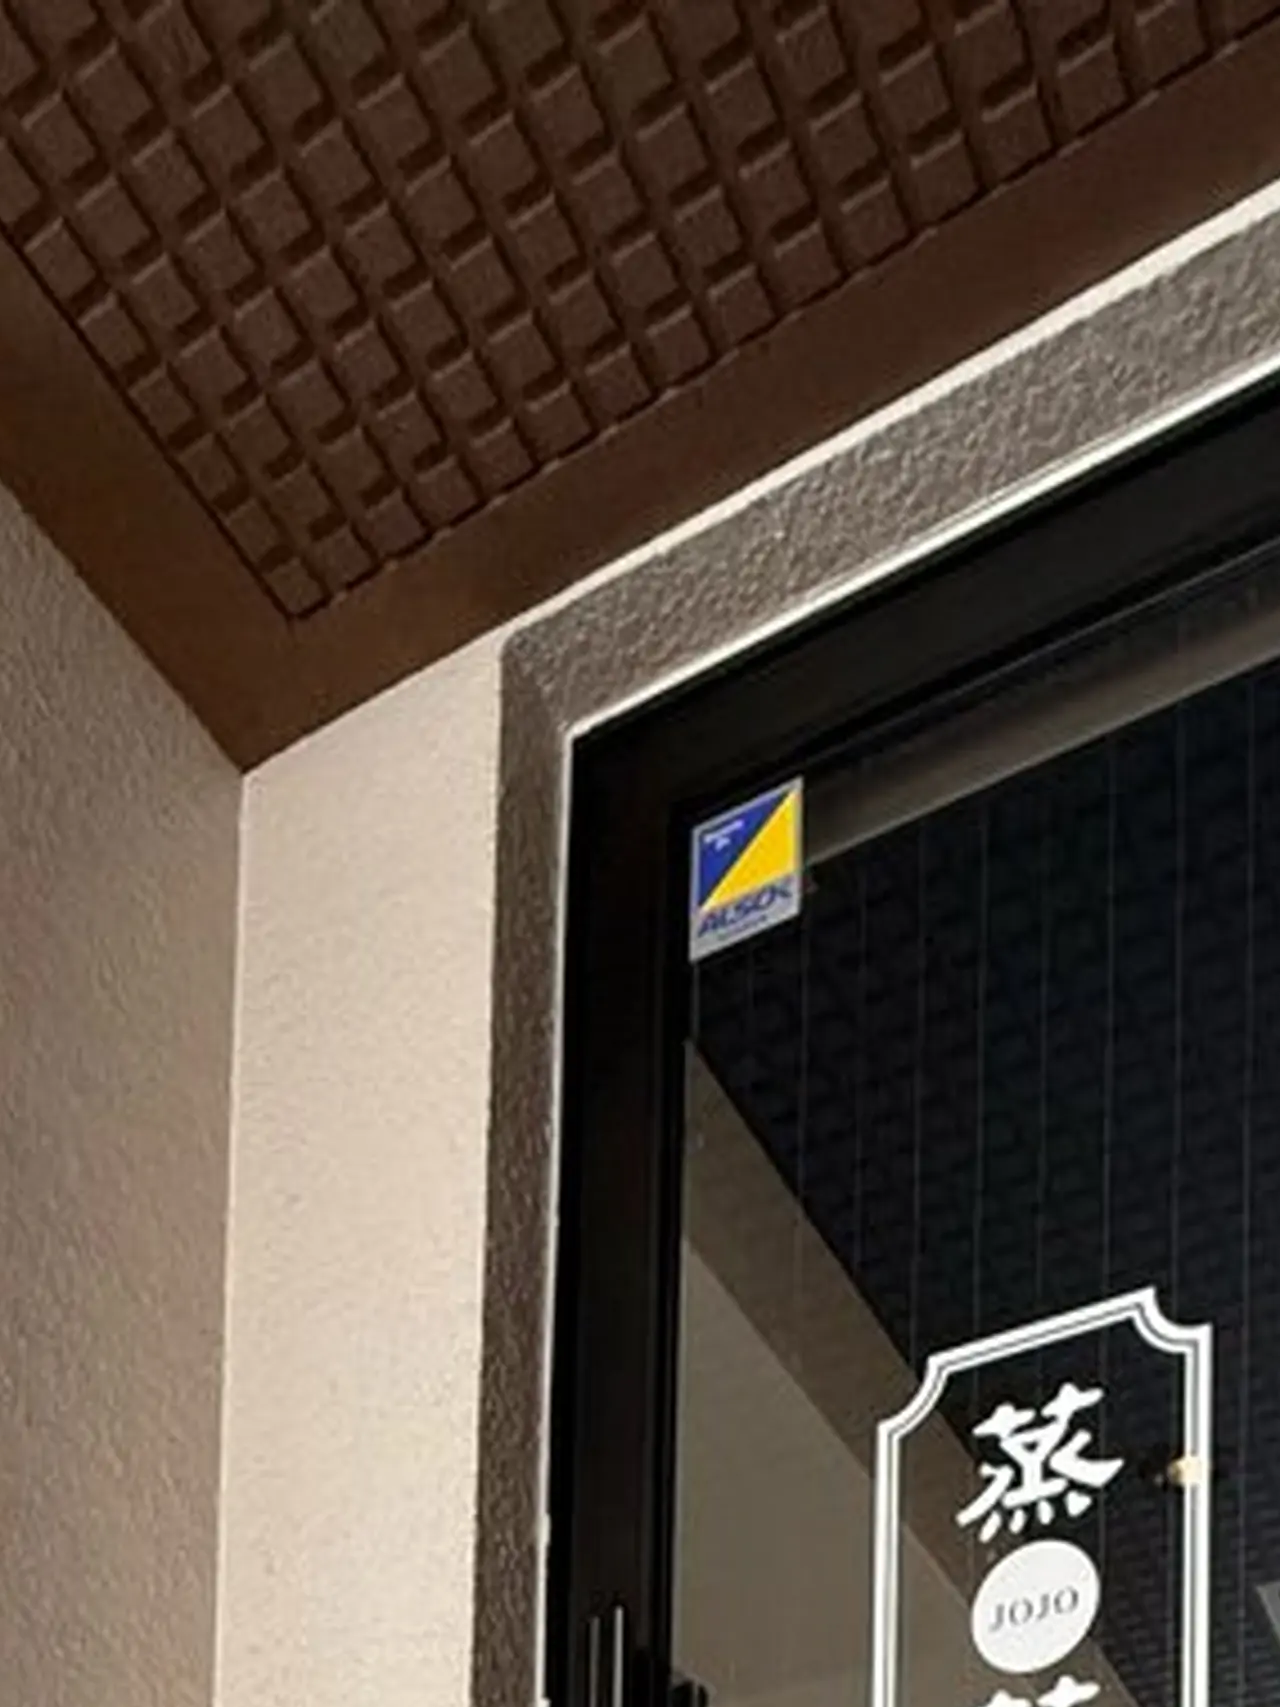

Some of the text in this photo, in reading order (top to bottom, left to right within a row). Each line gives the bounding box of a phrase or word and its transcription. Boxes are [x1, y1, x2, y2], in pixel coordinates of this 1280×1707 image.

[697, 878, 795, 939] ALSOK
[955, 1382, 1124, 1543] 蒸
[988, 1585, 1079, 1632] JOJO
